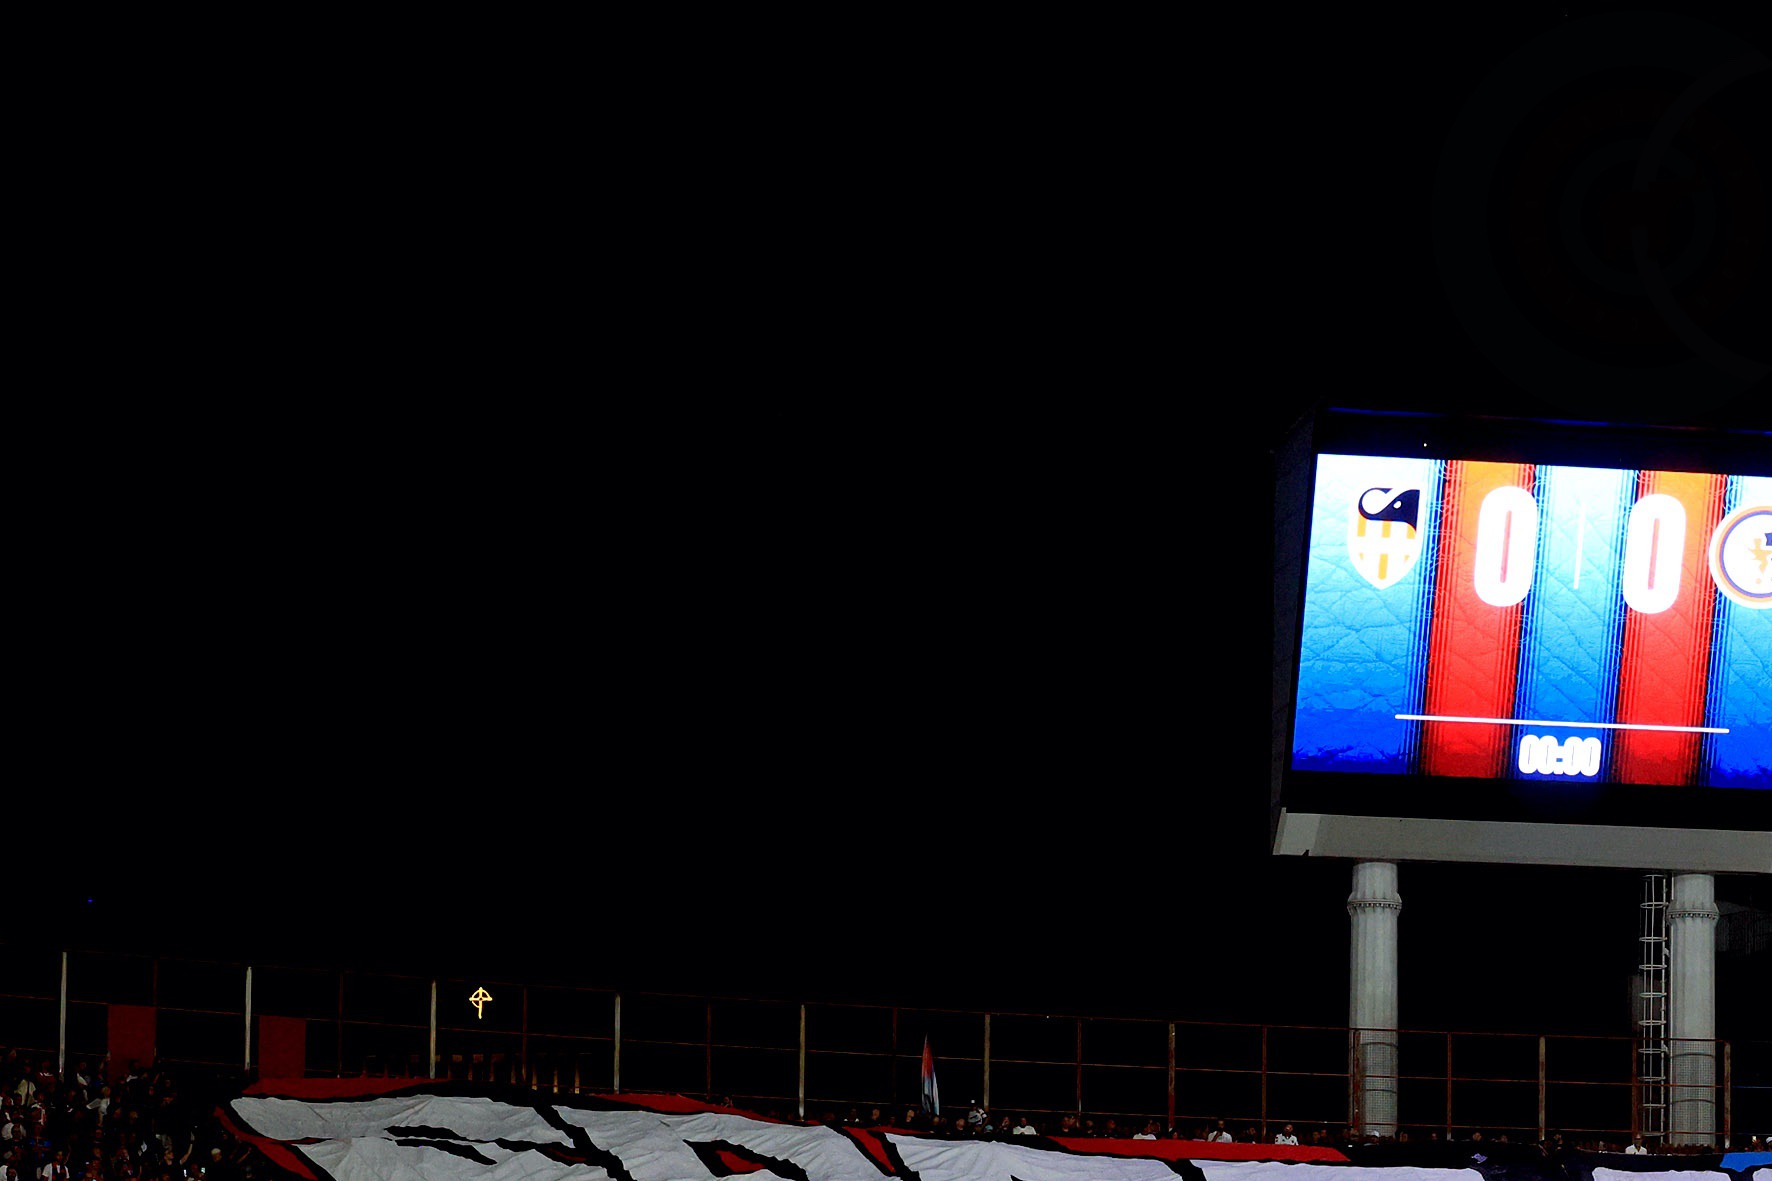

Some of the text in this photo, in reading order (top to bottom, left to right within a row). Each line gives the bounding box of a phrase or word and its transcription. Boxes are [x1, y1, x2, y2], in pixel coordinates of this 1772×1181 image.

[1474, 486, 1687, 613] 0 0
[1518, 734, 1602, 777] 00:00
